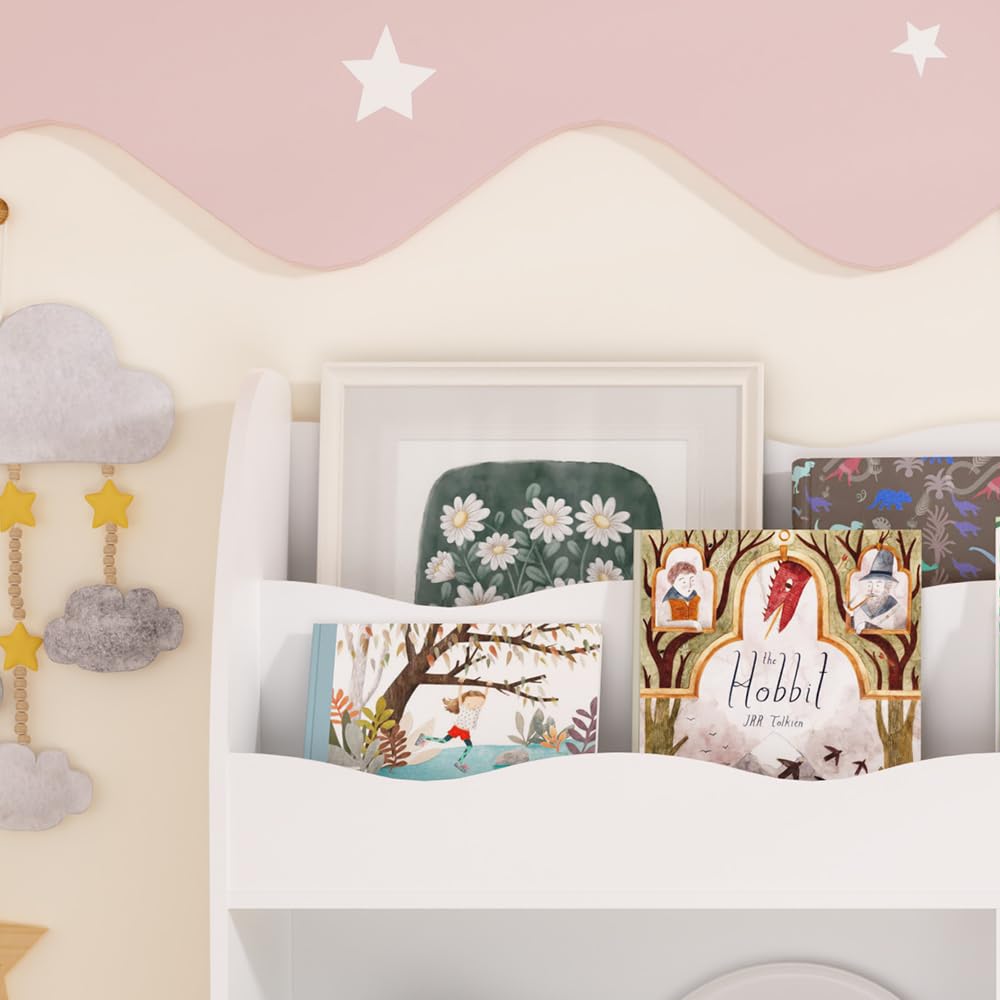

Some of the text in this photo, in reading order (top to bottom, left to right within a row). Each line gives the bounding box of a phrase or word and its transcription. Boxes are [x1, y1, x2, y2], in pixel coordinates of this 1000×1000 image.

[762, 651, 776, 664] the
[728, 650, 829, 709] Hobbit
[743, 714, 803, 727] JRR Tolkien
